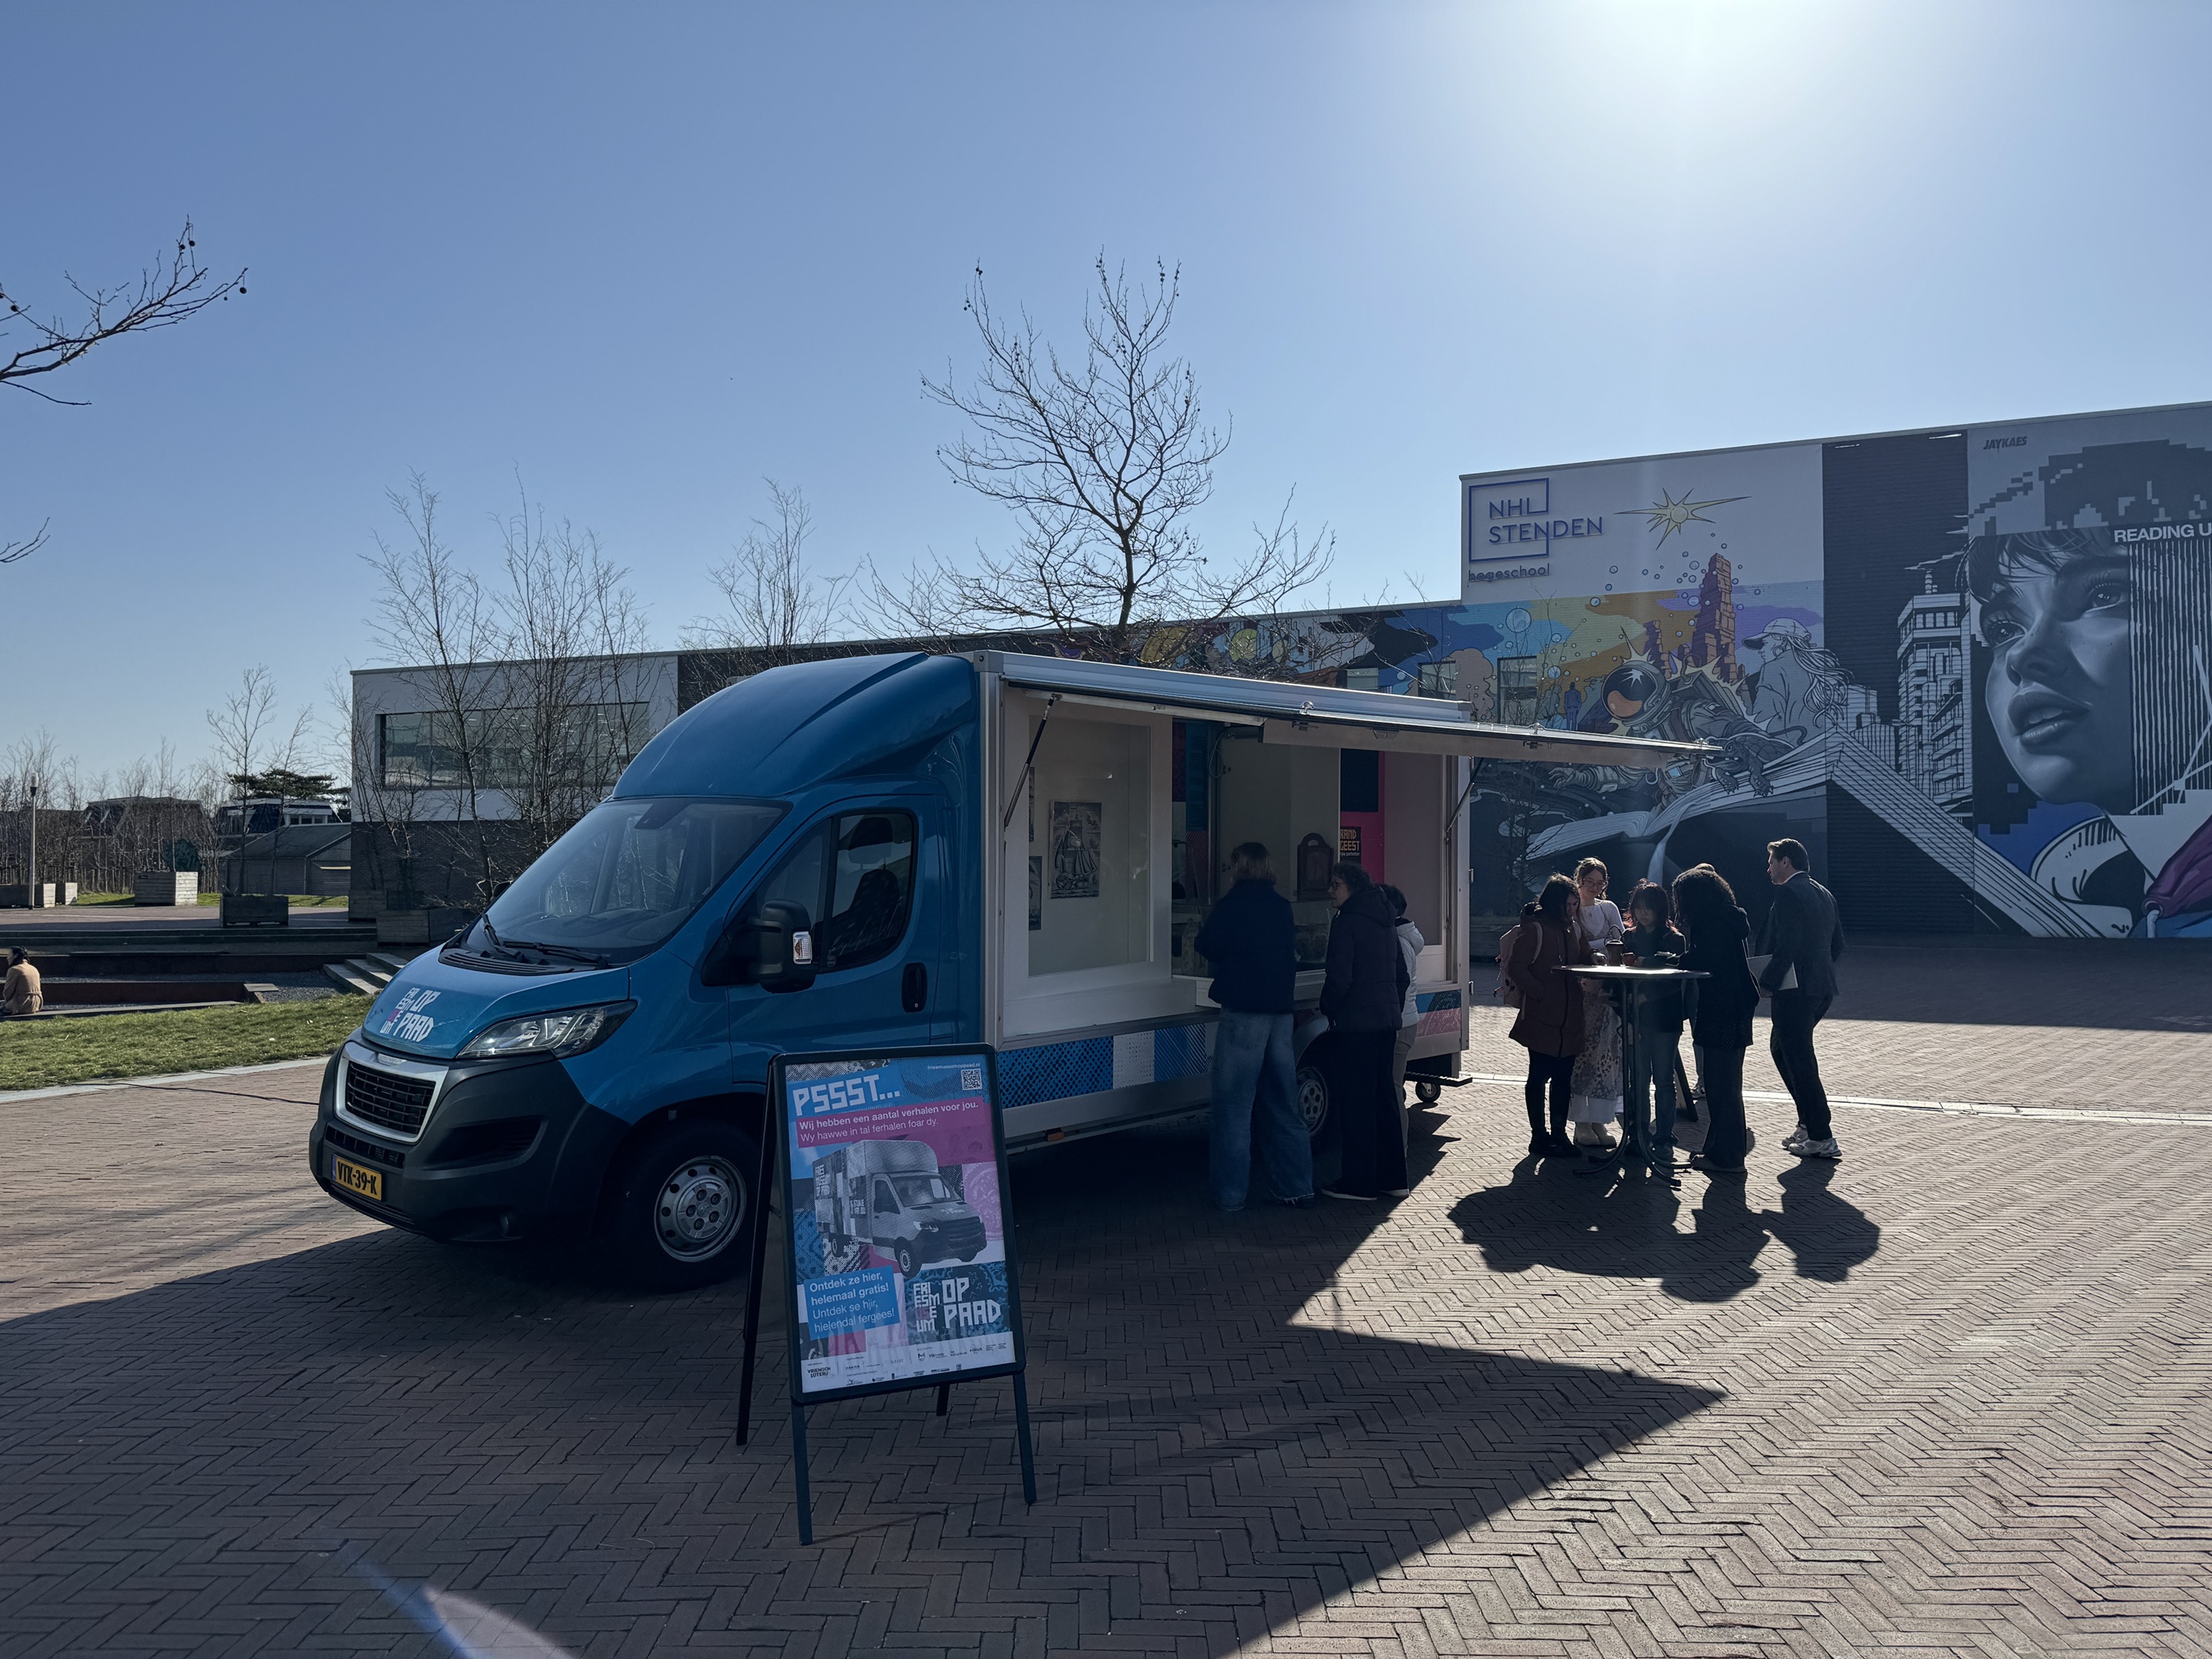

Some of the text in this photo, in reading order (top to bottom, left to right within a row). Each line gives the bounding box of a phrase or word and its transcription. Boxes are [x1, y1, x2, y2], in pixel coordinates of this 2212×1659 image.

[1983, 435, 2028, 451] JAYKAES
[1489, 498, 1545, 518] NHL
[1488, 516, 1602, 543] STENDEN
[2114, 524, 2195, 542] READING
[1469, 563, 1550, 582] hogeschool
[409, 989, 442, 1012] OP
[392, 1012, 434, 1042] PAAD
[793, 1074, 900, 1117] PSSST...
[800, 1121, 814, 1131] Wij
[816, 1118, 851, 1128] hebben
[872, 1110, 899, 1121] aantal
[901, 1107, 939, 1117] verhalen
[941, 1104, 960, 1112] voor
[962, 1101, 979, 1111] jou.
[800, 1118, 939, 1143] Wy hawwe in tal ferhalen foar dy.
[338, 1161, 377, 1195] VTK-39-K
[810, 1273, 882, 1292] Ontdek ze hier,
[811, 1282, 889, 1306] helemaal gratis!
[913, 1281, 931, 1295] FRI
[942, 1277, 970, 1303] OP
[813, 1300, 879, 1320] Untdek se hjir,
[914, 1293, 940, 1308] ESM
[814, 1307, 895, 1333] hielendal fergees!
[916, 1318, 935, 1333] UM
[943, 1299, 1002, 1329] PAAD
